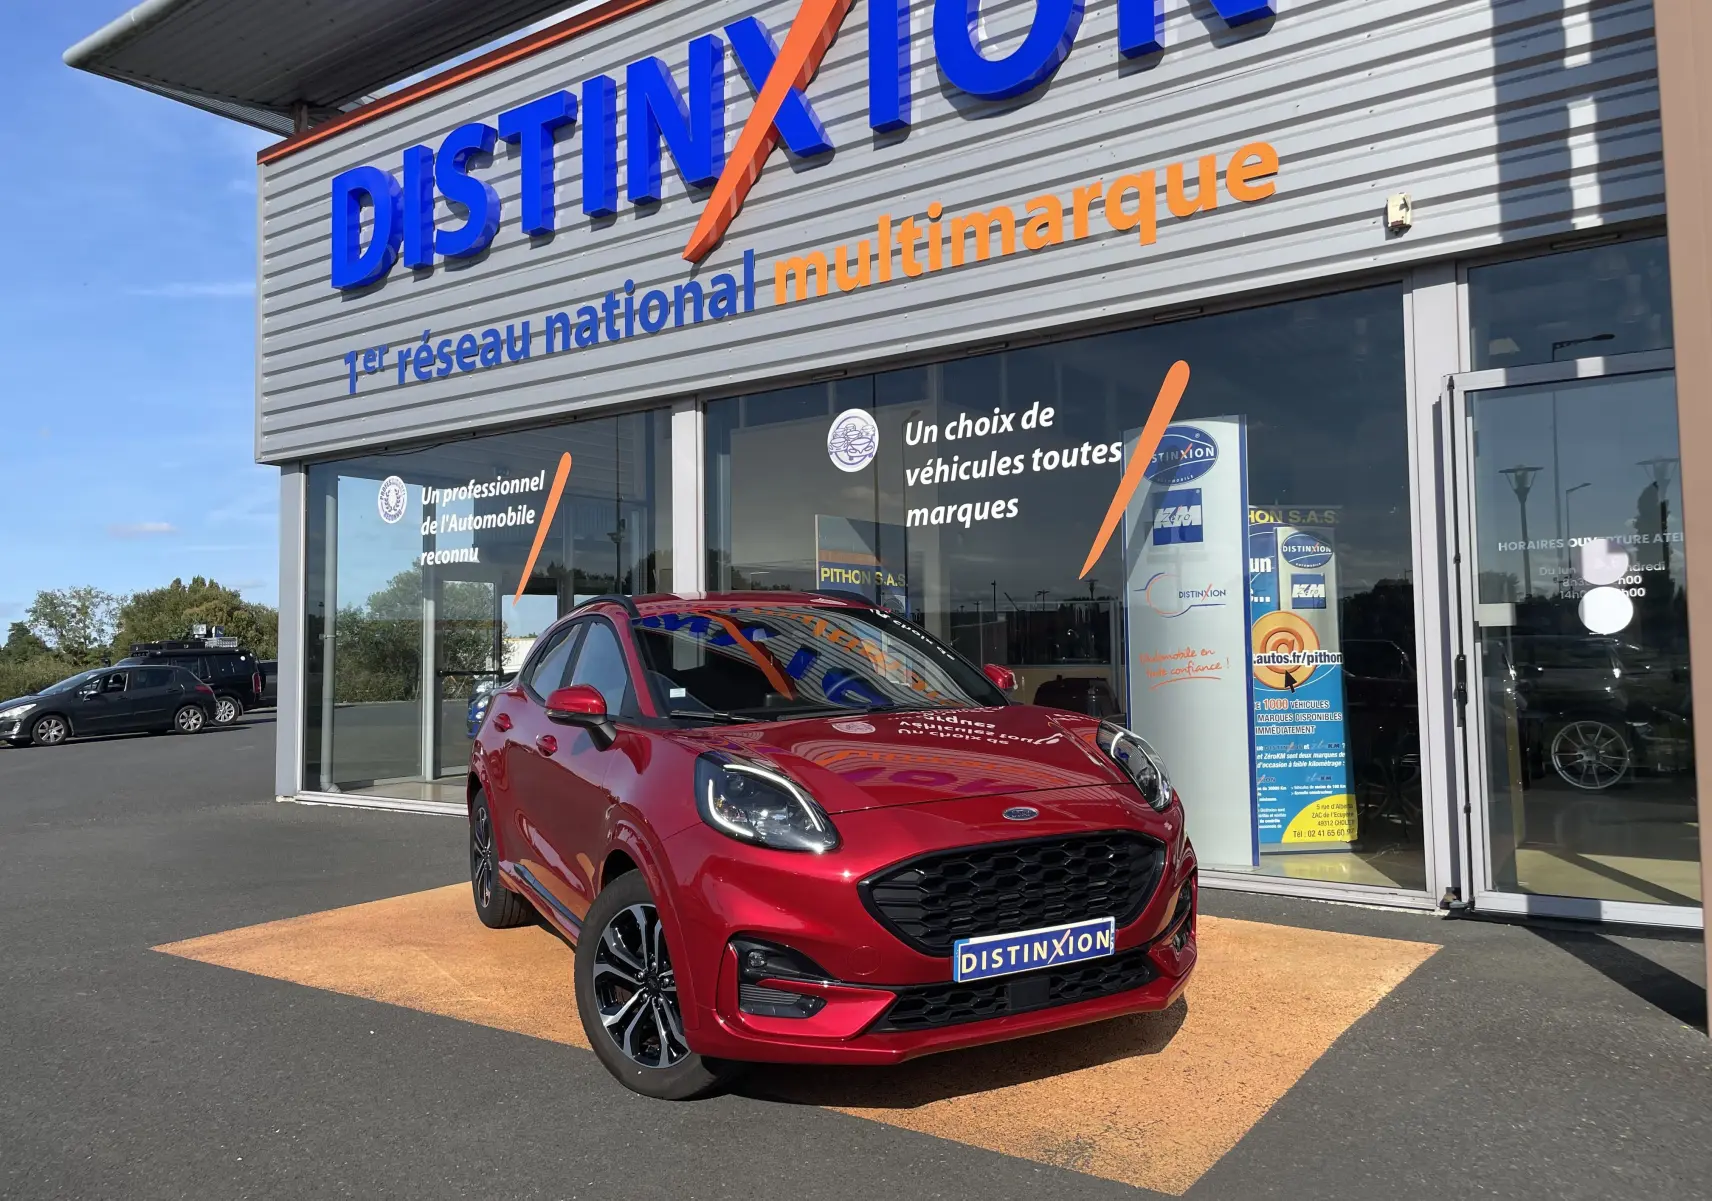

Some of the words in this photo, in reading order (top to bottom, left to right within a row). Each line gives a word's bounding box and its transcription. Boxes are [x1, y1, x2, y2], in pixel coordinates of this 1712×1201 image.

[331, 0, 1276, 290] DISTINXIO
[397, 328, 531, 385] réseau
[545, 248, 756, 354] national
[774, 141, 1280, 306] multimarque
[905, 420, 938, 446] Un
[944, 406, 1015, 440] choix
[1020, 400, 1055, 429] de
[905, 448, 1025, 487] véhicules
[1031, 440, 1123, 471] toutes
[1151, 442, 1215, 464] STINXION
[421, 486, 440, 505] Un
[442, 469, 546, 507] professionnel
[420, 516, 437, 535] de
[440, 504, 536, 534] l'Automobile
[905, 497, 1020, 528] marques
[1498, 538, 1564, 551] HORAIRES
[420, 547, 480, 565] reconnu
[820, 567, 871, 586] PITHON
[1178, 583, 1226, 602] DISTINXION
[1200, 648, 1215, 656] en
[1170, 660, 1222, 676] confiance
[1263, 698, 1289, 710] 1000
[1257, 713, 1293, 723] MARQUES
[1295, 712, 1343, 722] DISPONIBLES
[961, 928, 1110, 975] DISTINXION
